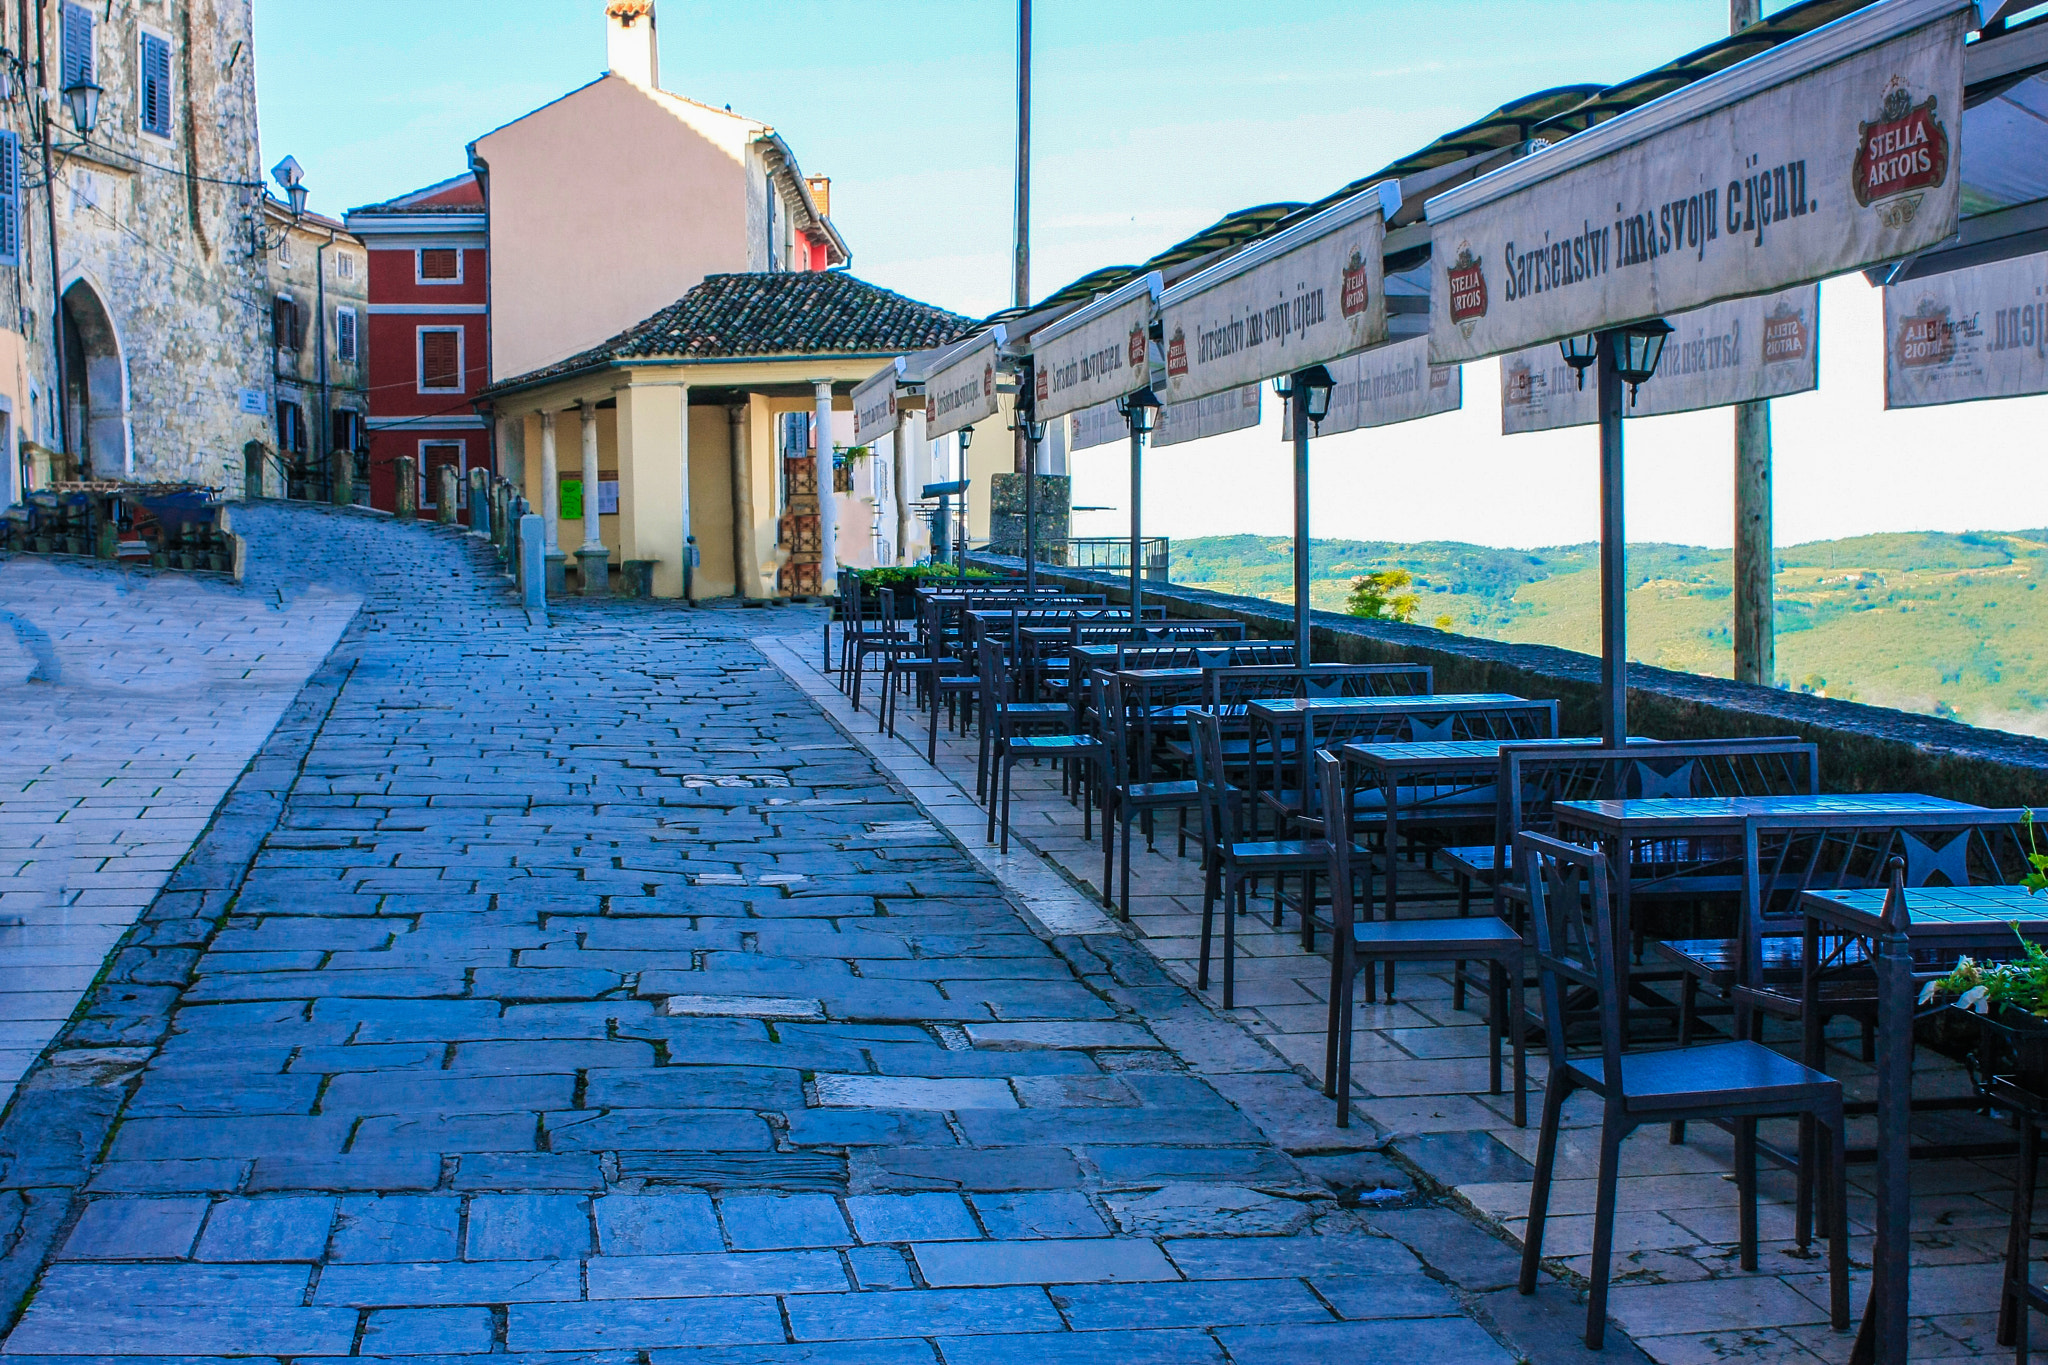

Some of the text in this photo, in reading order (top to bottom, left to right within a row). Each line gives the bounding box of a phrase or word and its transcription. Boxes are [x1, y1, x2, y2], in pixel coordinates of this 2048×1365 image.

[1869, 121, 1929, 161] STELLA
[1868, 148, 1932, 188] ARTOIS
[1505, 153, 1818, 302] Savršenstvo ima svoju cijenu.
[1451, 272, 1480, 294] STELLA
